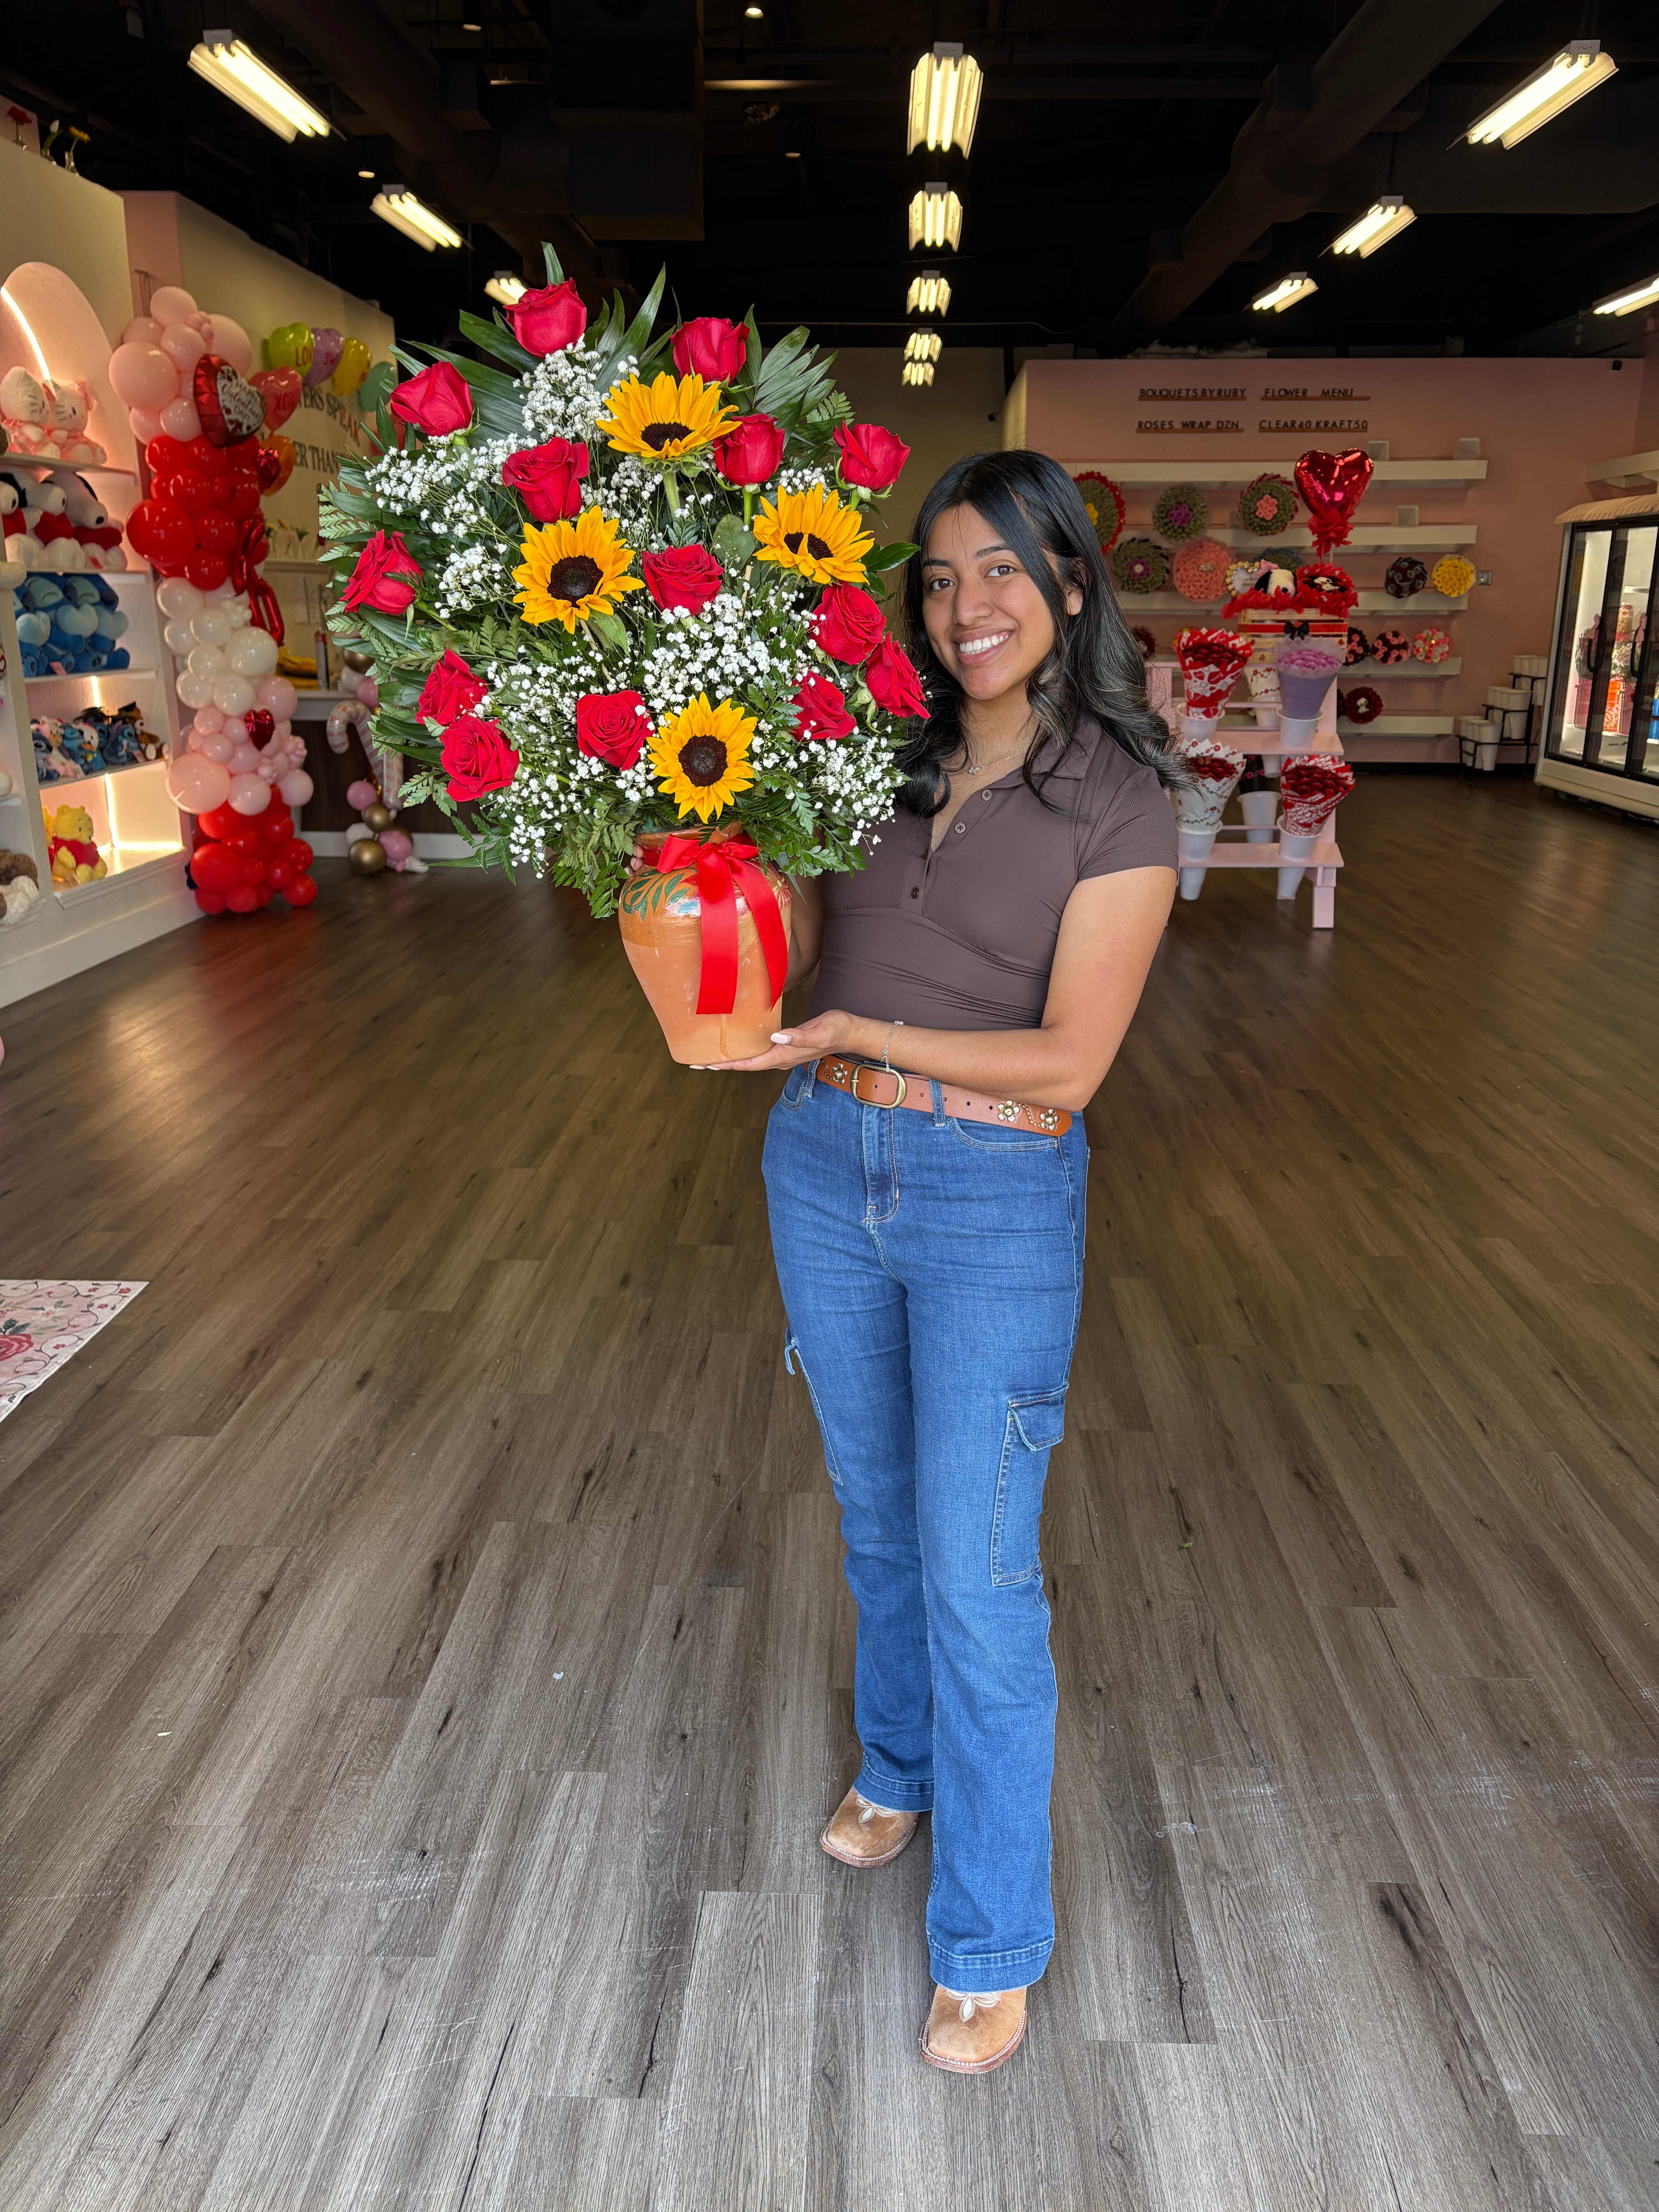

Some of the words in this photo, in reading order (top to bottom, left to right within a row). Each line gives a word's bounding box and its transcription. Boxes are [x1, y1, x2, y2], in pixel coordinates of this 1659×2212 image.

[1139, 388, 1199, 397] BOUQUETS
[1264, 388, 1308, 397] FLOWER
[1321, 388, 1354, 397] MENU
[1138, 420, 1174, 429] ROSES
[1181, 420, 1211, 429] WRAP
[1216, 420, 1240, 429] DZN
